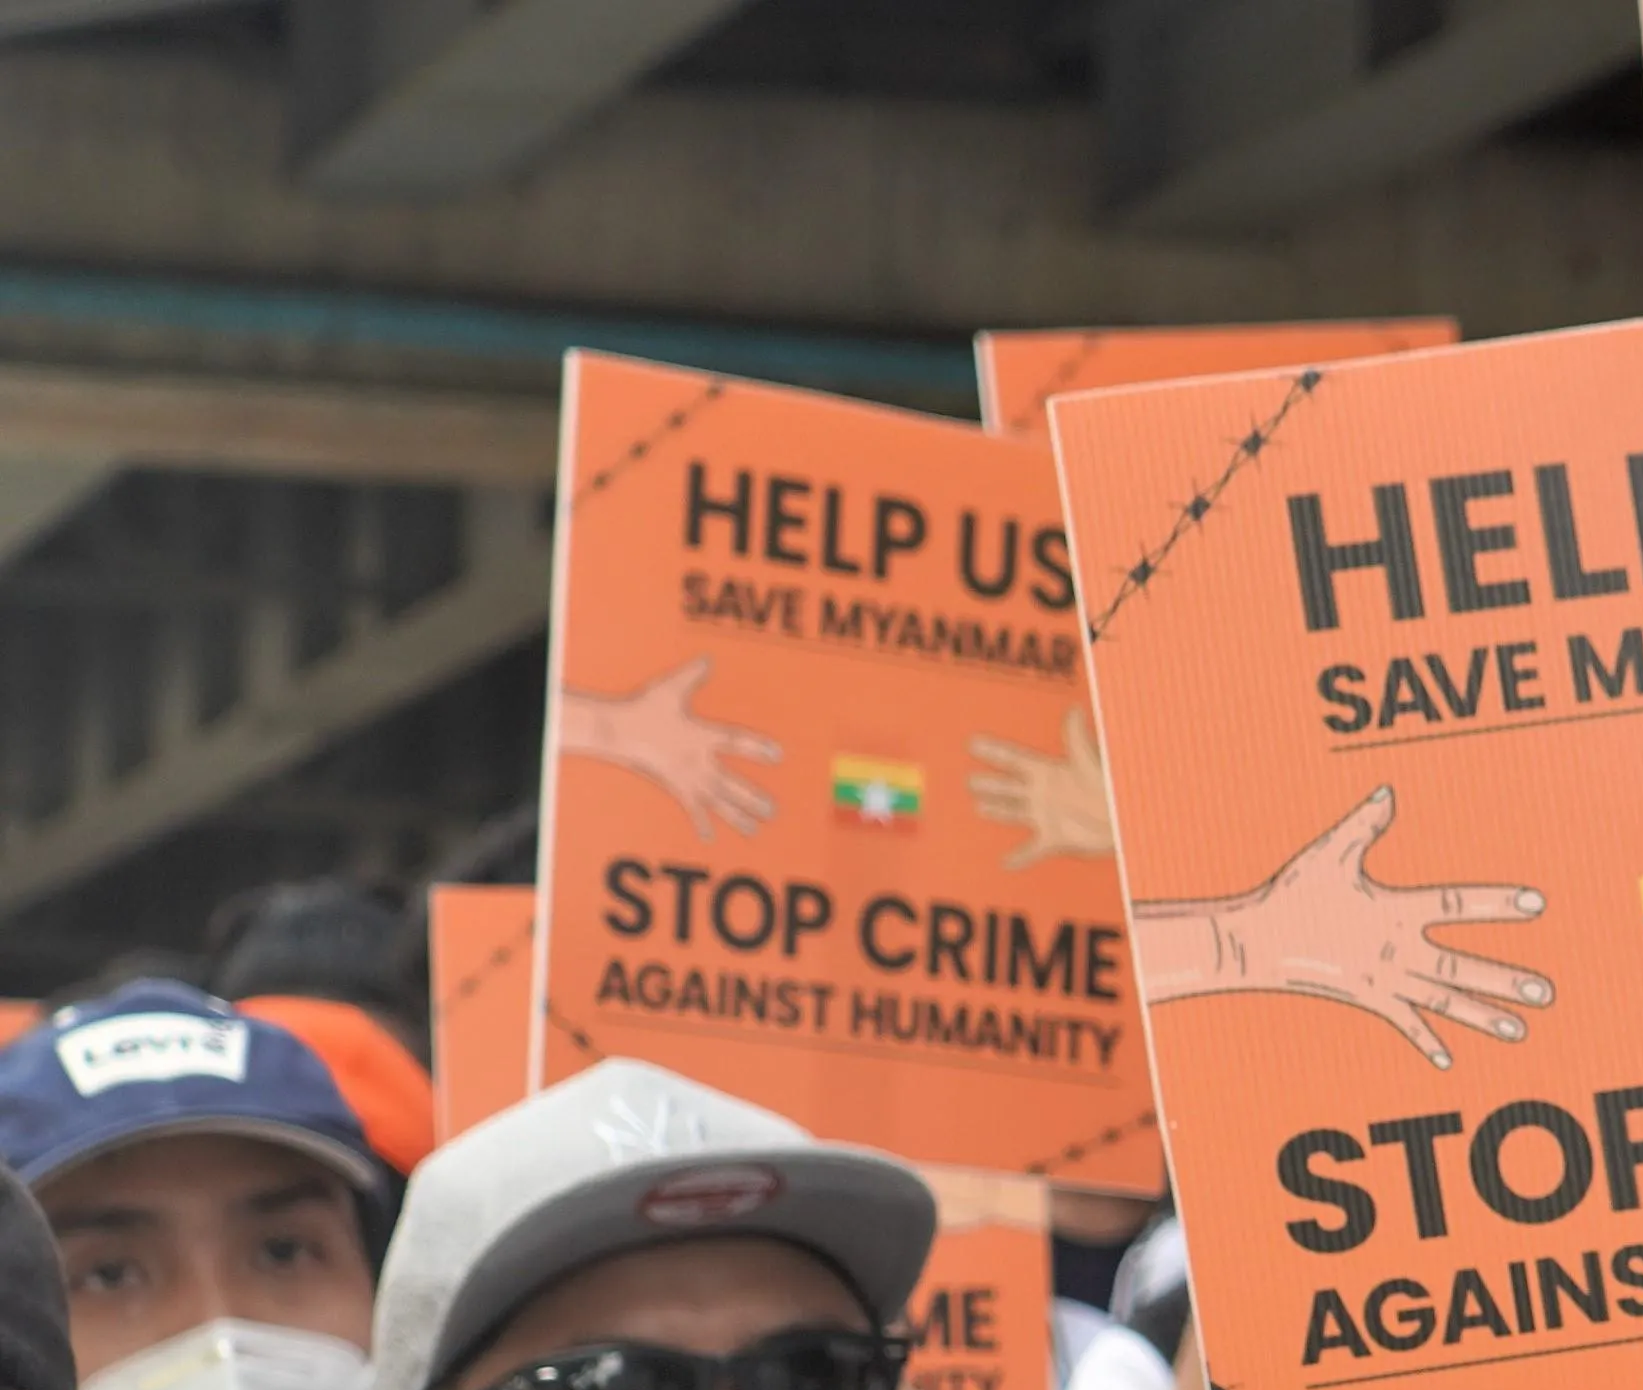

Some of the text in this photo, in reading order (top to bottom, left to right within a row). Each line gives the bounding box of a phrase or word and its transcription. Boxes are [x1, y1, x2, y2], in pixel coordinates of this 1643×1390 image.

[683, 460, 1077, 613] HELP US
[681, 570, 1078, 679] SAVE MYANMAR
[1314, 639, 1546, 736] SAVE
[602, 858, 1125, 1001] STOP CRIME
[596, 956, 1124, 1067] AGAINST HUMANITY
